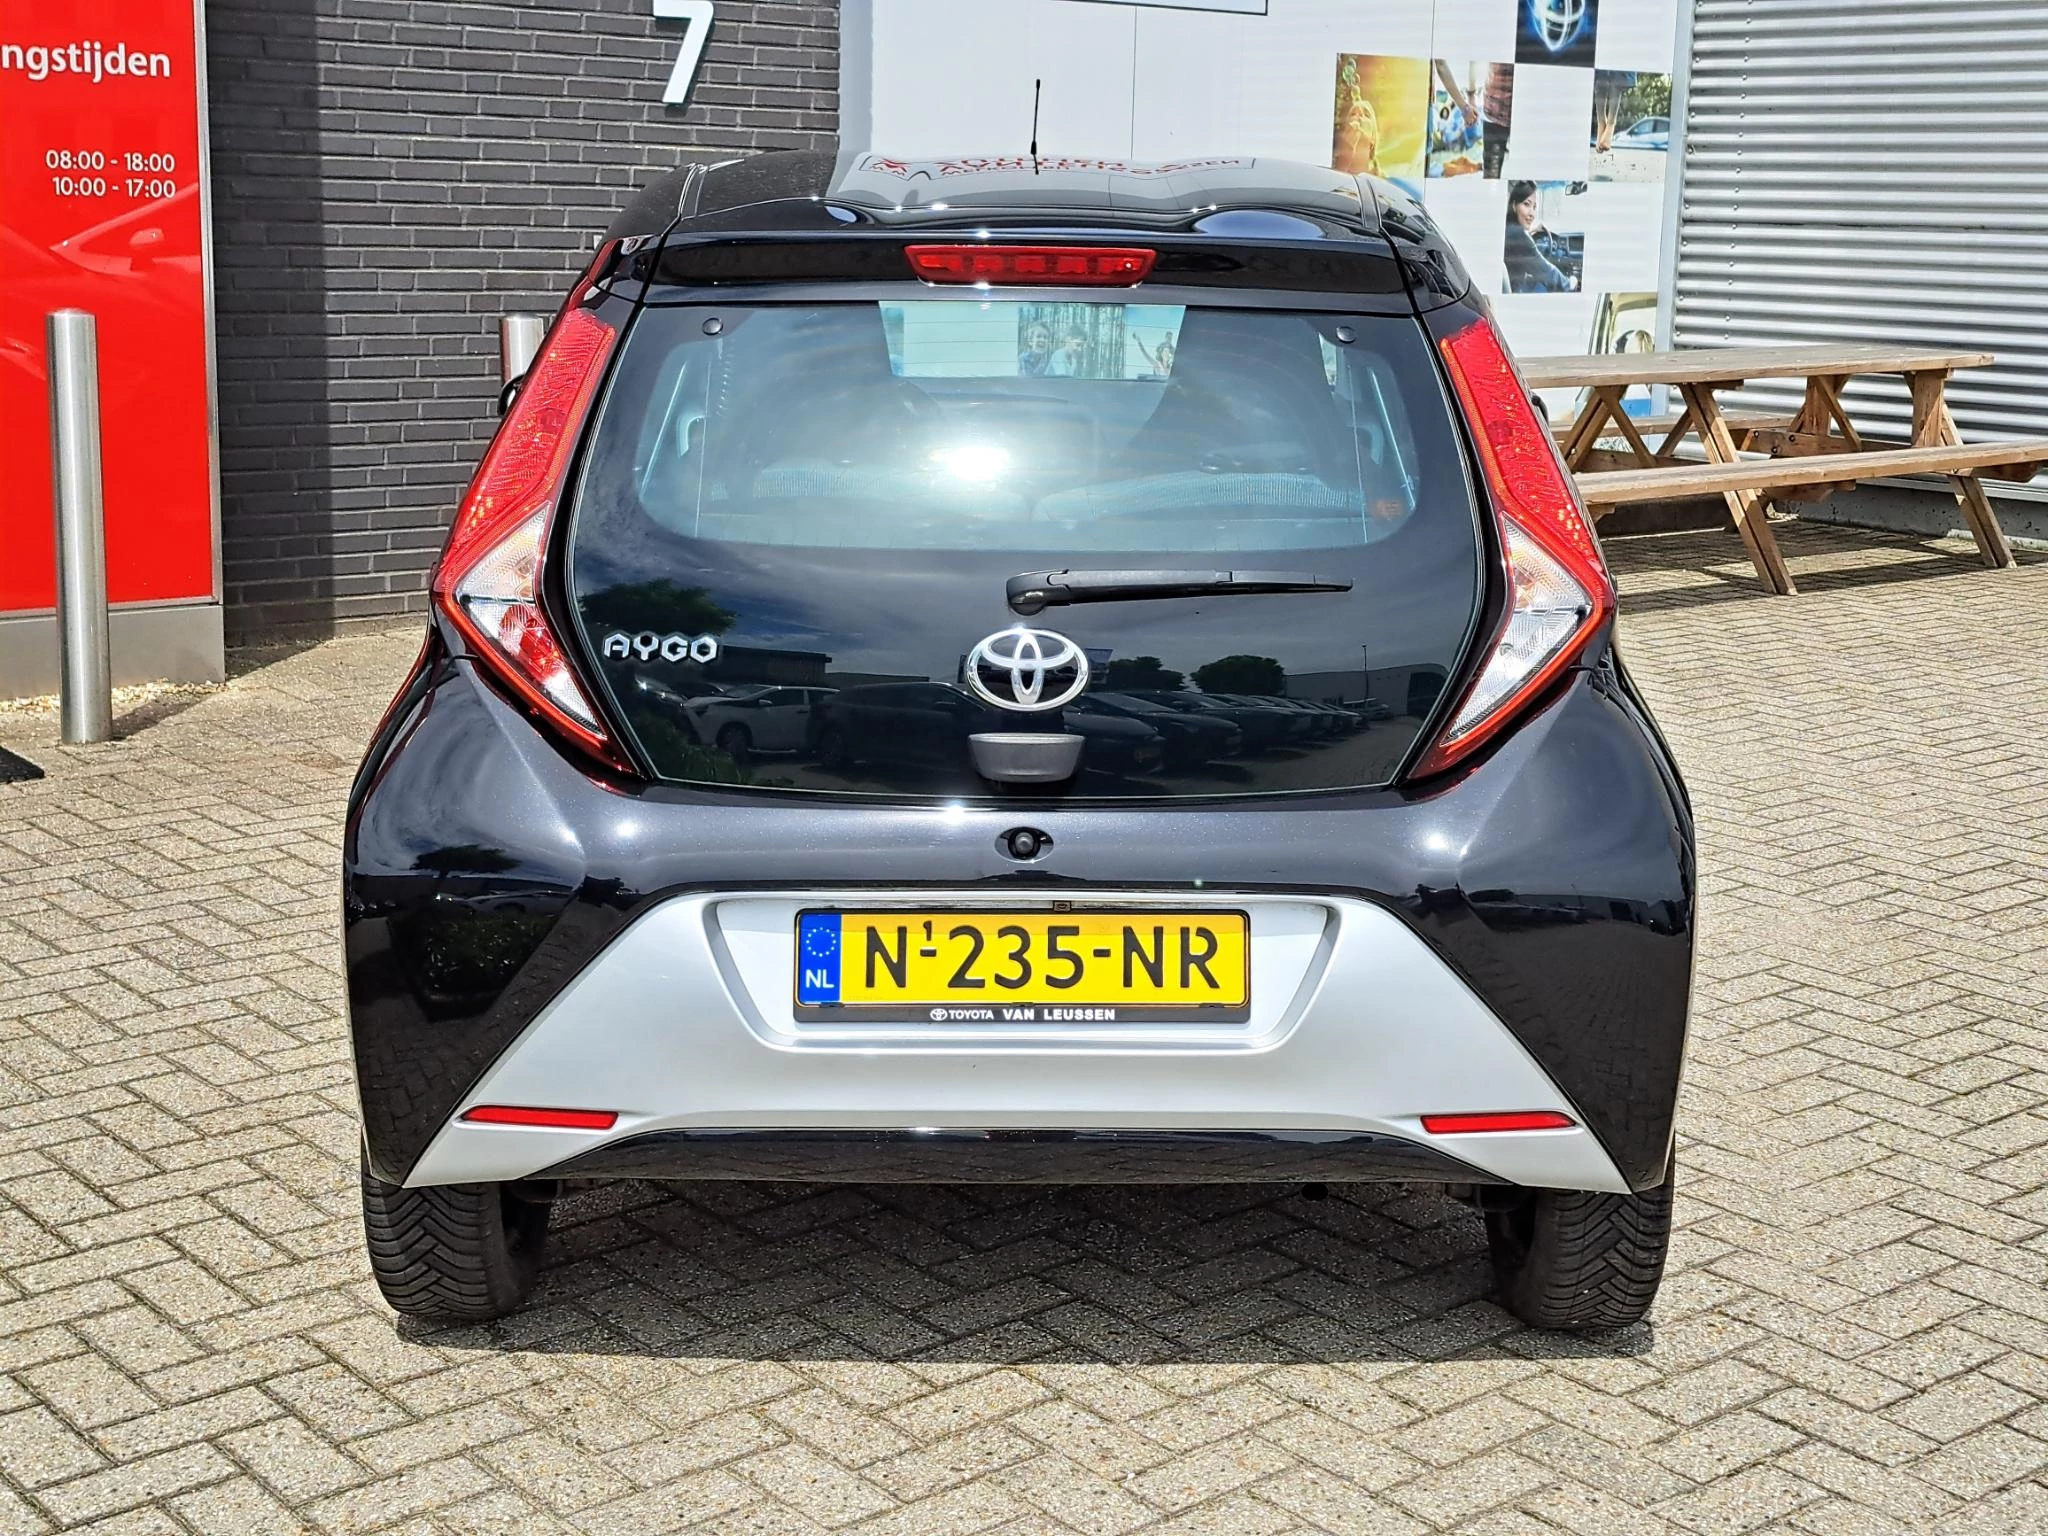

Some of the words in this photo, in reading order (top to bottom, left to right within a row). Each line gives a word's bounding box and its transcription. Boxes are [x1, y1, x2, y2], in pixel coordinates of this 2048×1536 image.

[653, 0, 714, 103] 7
[46, 149, 105, 170] 08:00
[123, 152, 175, 173] 18:00
[52, 176, 106, 197] 10:00
[125, 178, 176, 198] 17:00
[603, 633, 718, 664] AYGO
[805, 969, 834, 988] NL
[949, 1009, 994, 1020] TOYOTA
[1002, 1008, 1035, 1020] VAN
[1043, 1008, 1116, 1020] LEUSSEN
